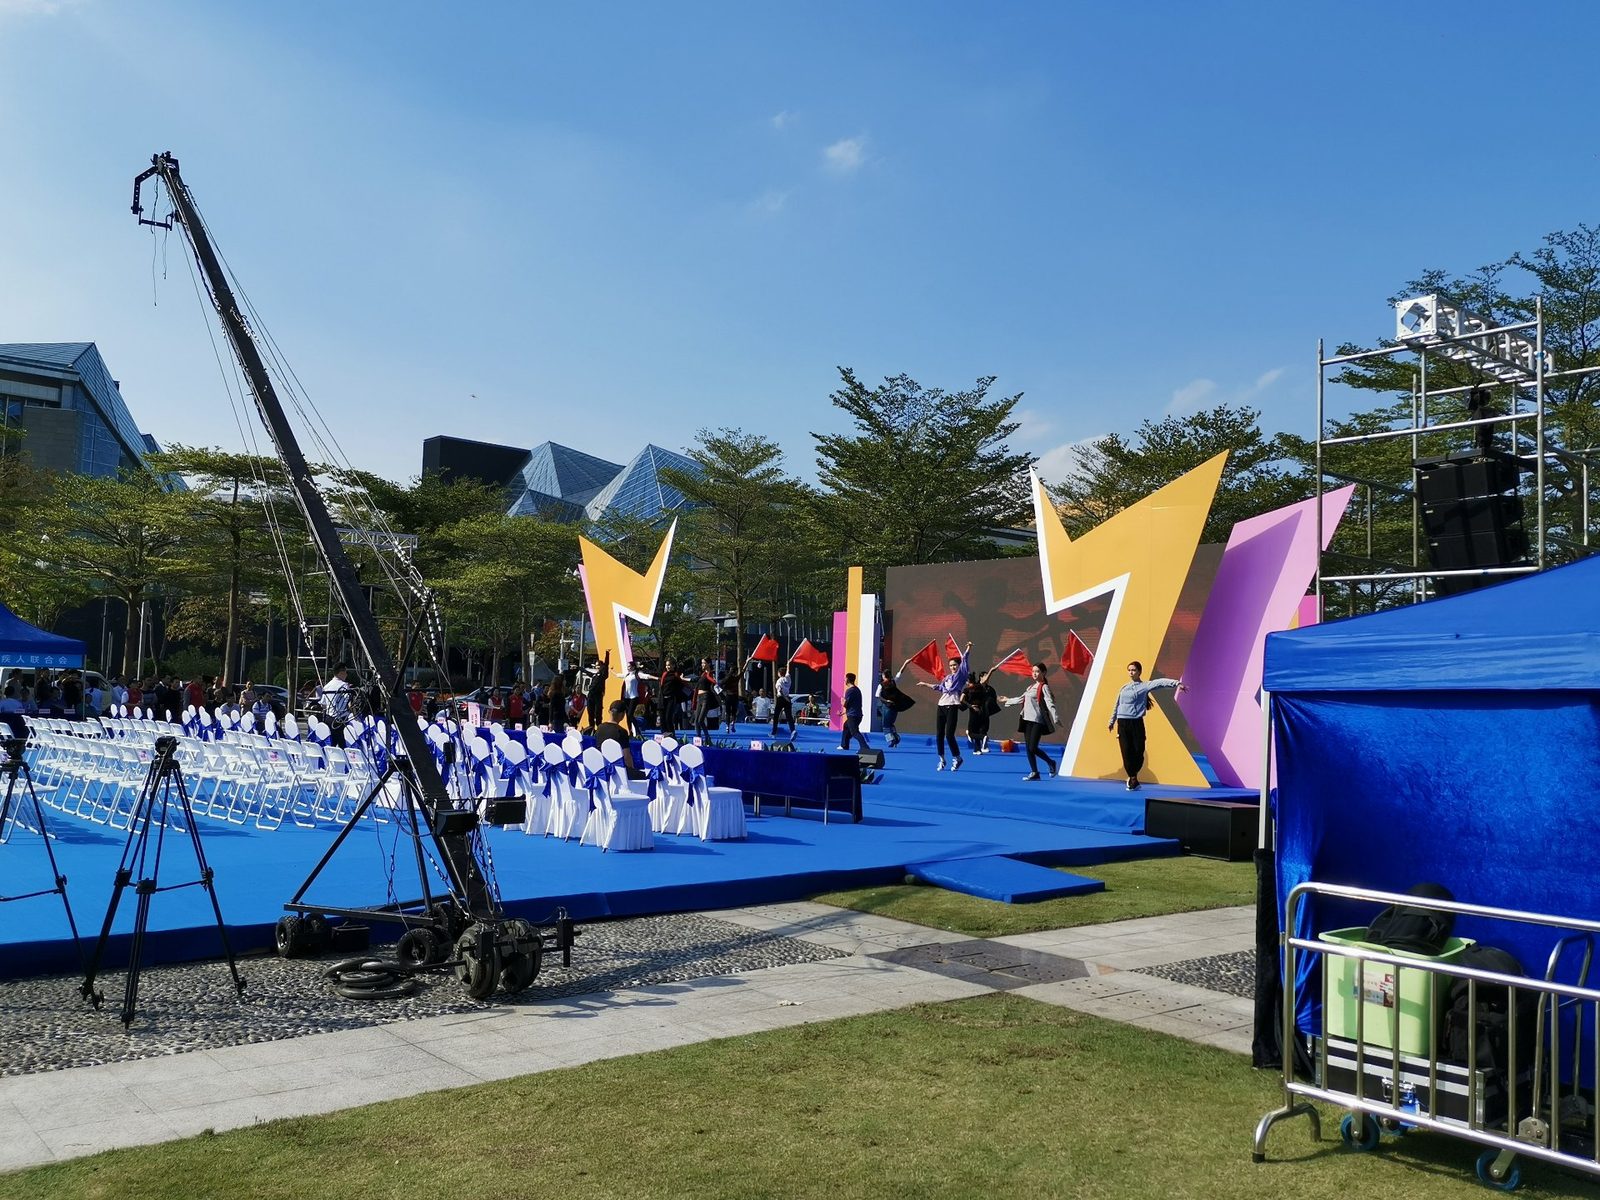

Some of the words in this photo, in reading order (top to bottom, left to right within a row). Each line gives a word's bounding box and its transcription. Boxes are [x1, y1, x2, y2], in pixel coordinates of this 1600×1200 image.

[1, 654, 68, 665] 疾人联合会
